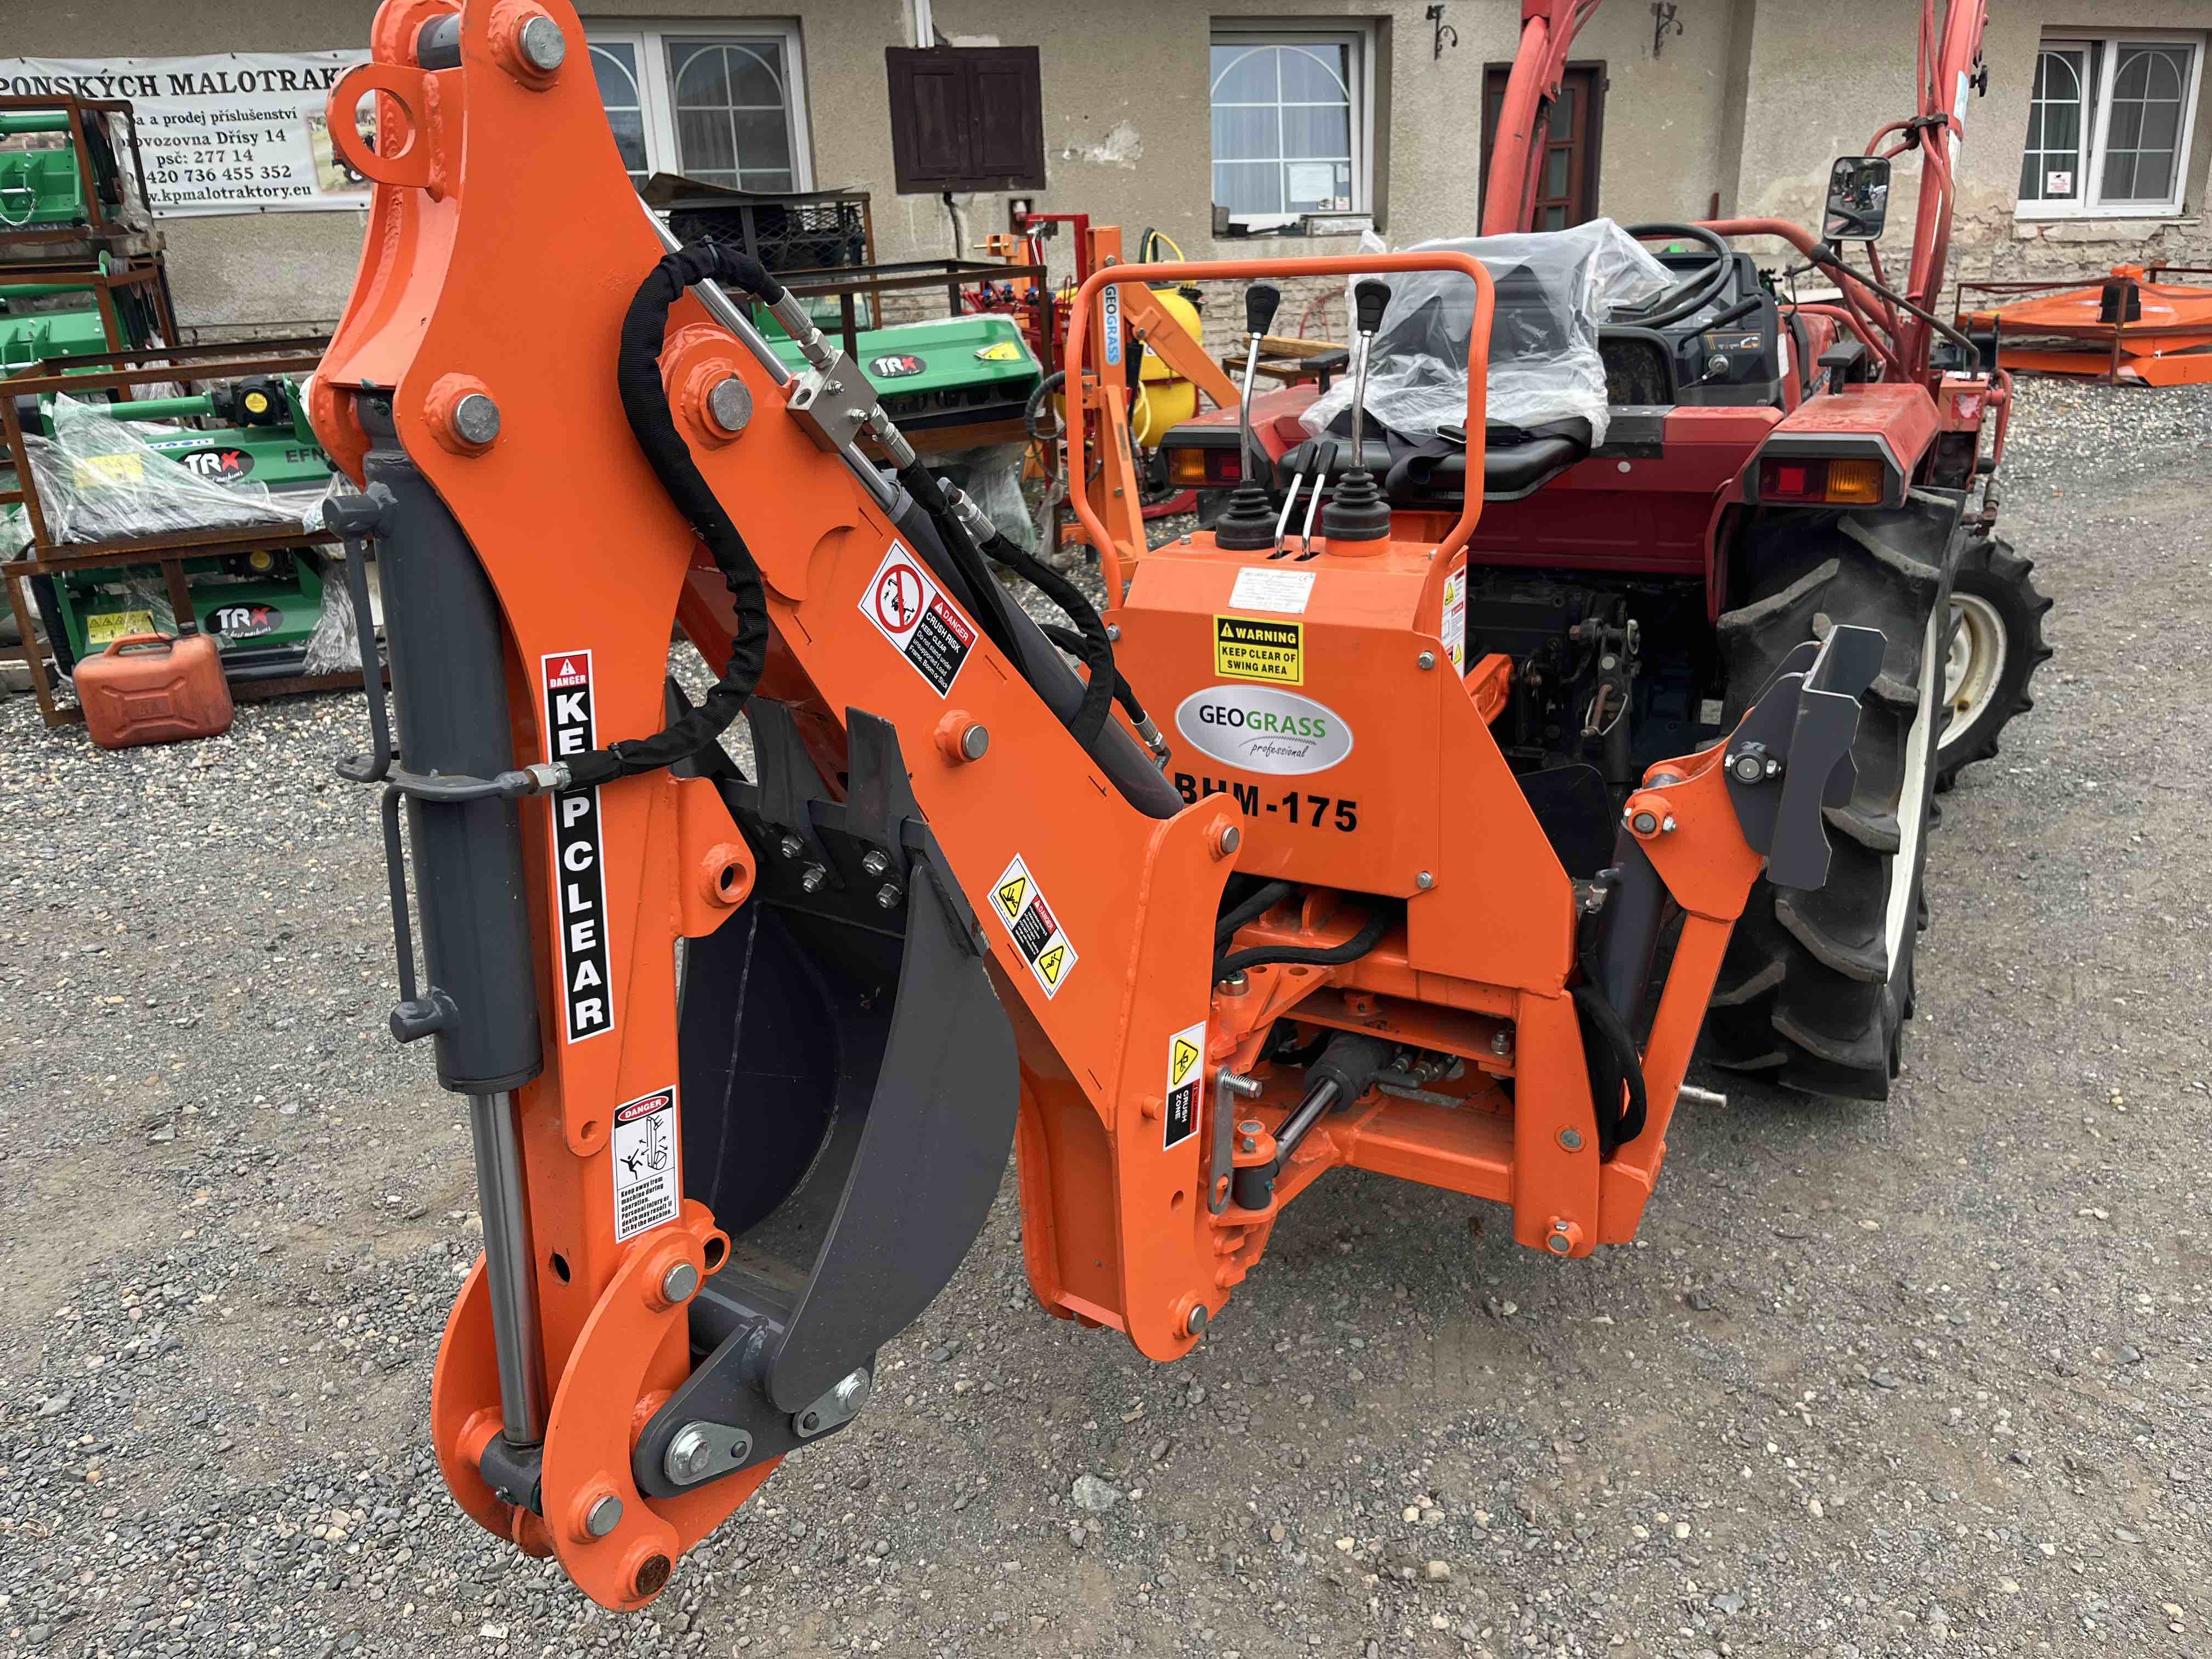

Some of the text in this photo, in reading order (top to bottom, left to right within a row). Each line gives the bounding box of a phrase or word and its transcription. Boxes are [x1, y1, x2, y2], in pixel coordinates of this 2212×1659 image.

[150, 116, 158, 125] a
[162, 110, 206, 127] prodej
[210, 106, 297, 126] příslušenství
[215, 129, 258, 146] Dřísy
[265, 128, 286, 142] 14
[156, 149, 253, 168] psč: 277 14
[146, 170, 178, 184] 420
[184, 168, 216, 182] 736
[222, 166, 254, 180] 455
[260, 165, 291, 179] 352
[1105, 286, 1119, 364] GEOGRASS
[875, 357, 917, 373] TRX
[184, 450, 240, 475] TRX
[216, 607, 270, 629] TRX
[943, 610, 969, 642] DANGER
[921, 623, 946, 653] KEEP CLEAR
[926, 612, 961, 653] CRUSH RISK
[1235, 627, 1296, 645] WARNING
[913, 639, 947, 676] unsupported Load
[917, 630, 924, 640] Do
[929, 645, 941, 658] stand
[940, 655, 952, 670] under
[1222, 646, 1296, 663] KEEP CLEAR OF
[923, 659, 934, 675] Boom
[938, 676, 948, 689] Stick
[1227, 660, 1287, 675] SWING AREA
[550, 675, 586, 688] DANGER
[1199, 704, 1327, 738] GEOGRASS
[1249, 741, 1309, 758] professional
[556, 692, 604, 1031] KEP CLEAR
[1038, 905, 1053, 930] DANGER
[625, 1099, 662, 1119] DANGER
[1181, 1090, 1189, 1122] CRUSH
[620, 1176, 663, 1198] Keep away from
[621, 1183, 664, 1205] machine during
[622, 1204, 646, 1220] Personal
[647, 1198, 663, 1210] injury
[622, 1216, 637, 1227] death
[639, 1211, 650, 1220] may
[650, 1203, 667, 1214] result
[637, 1219, 647, 1227] the
